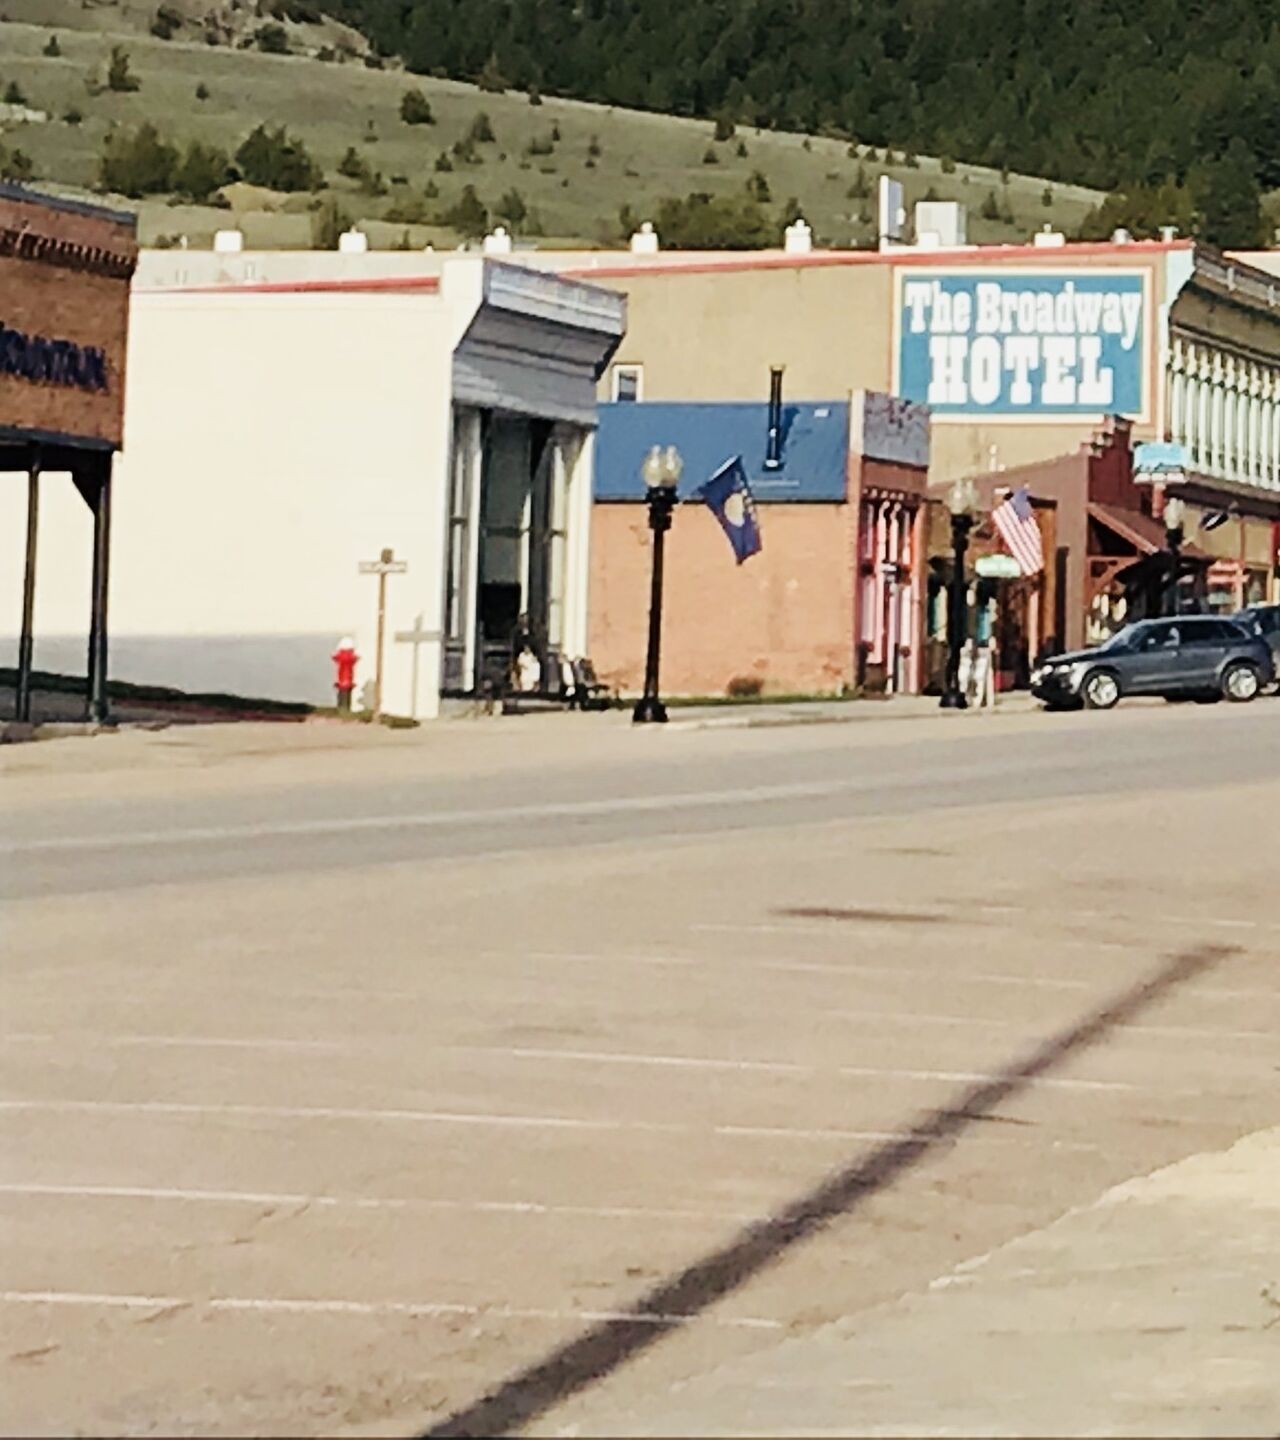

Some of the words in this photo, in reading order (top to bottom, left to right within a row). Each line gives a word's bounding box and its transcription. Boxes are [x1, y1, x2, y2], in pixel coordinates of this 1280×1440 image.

[904, 279, 972, 334] The
[975, 280, 1142, 351] Broadway
[927, 335, 1114, 406] HOTEL
